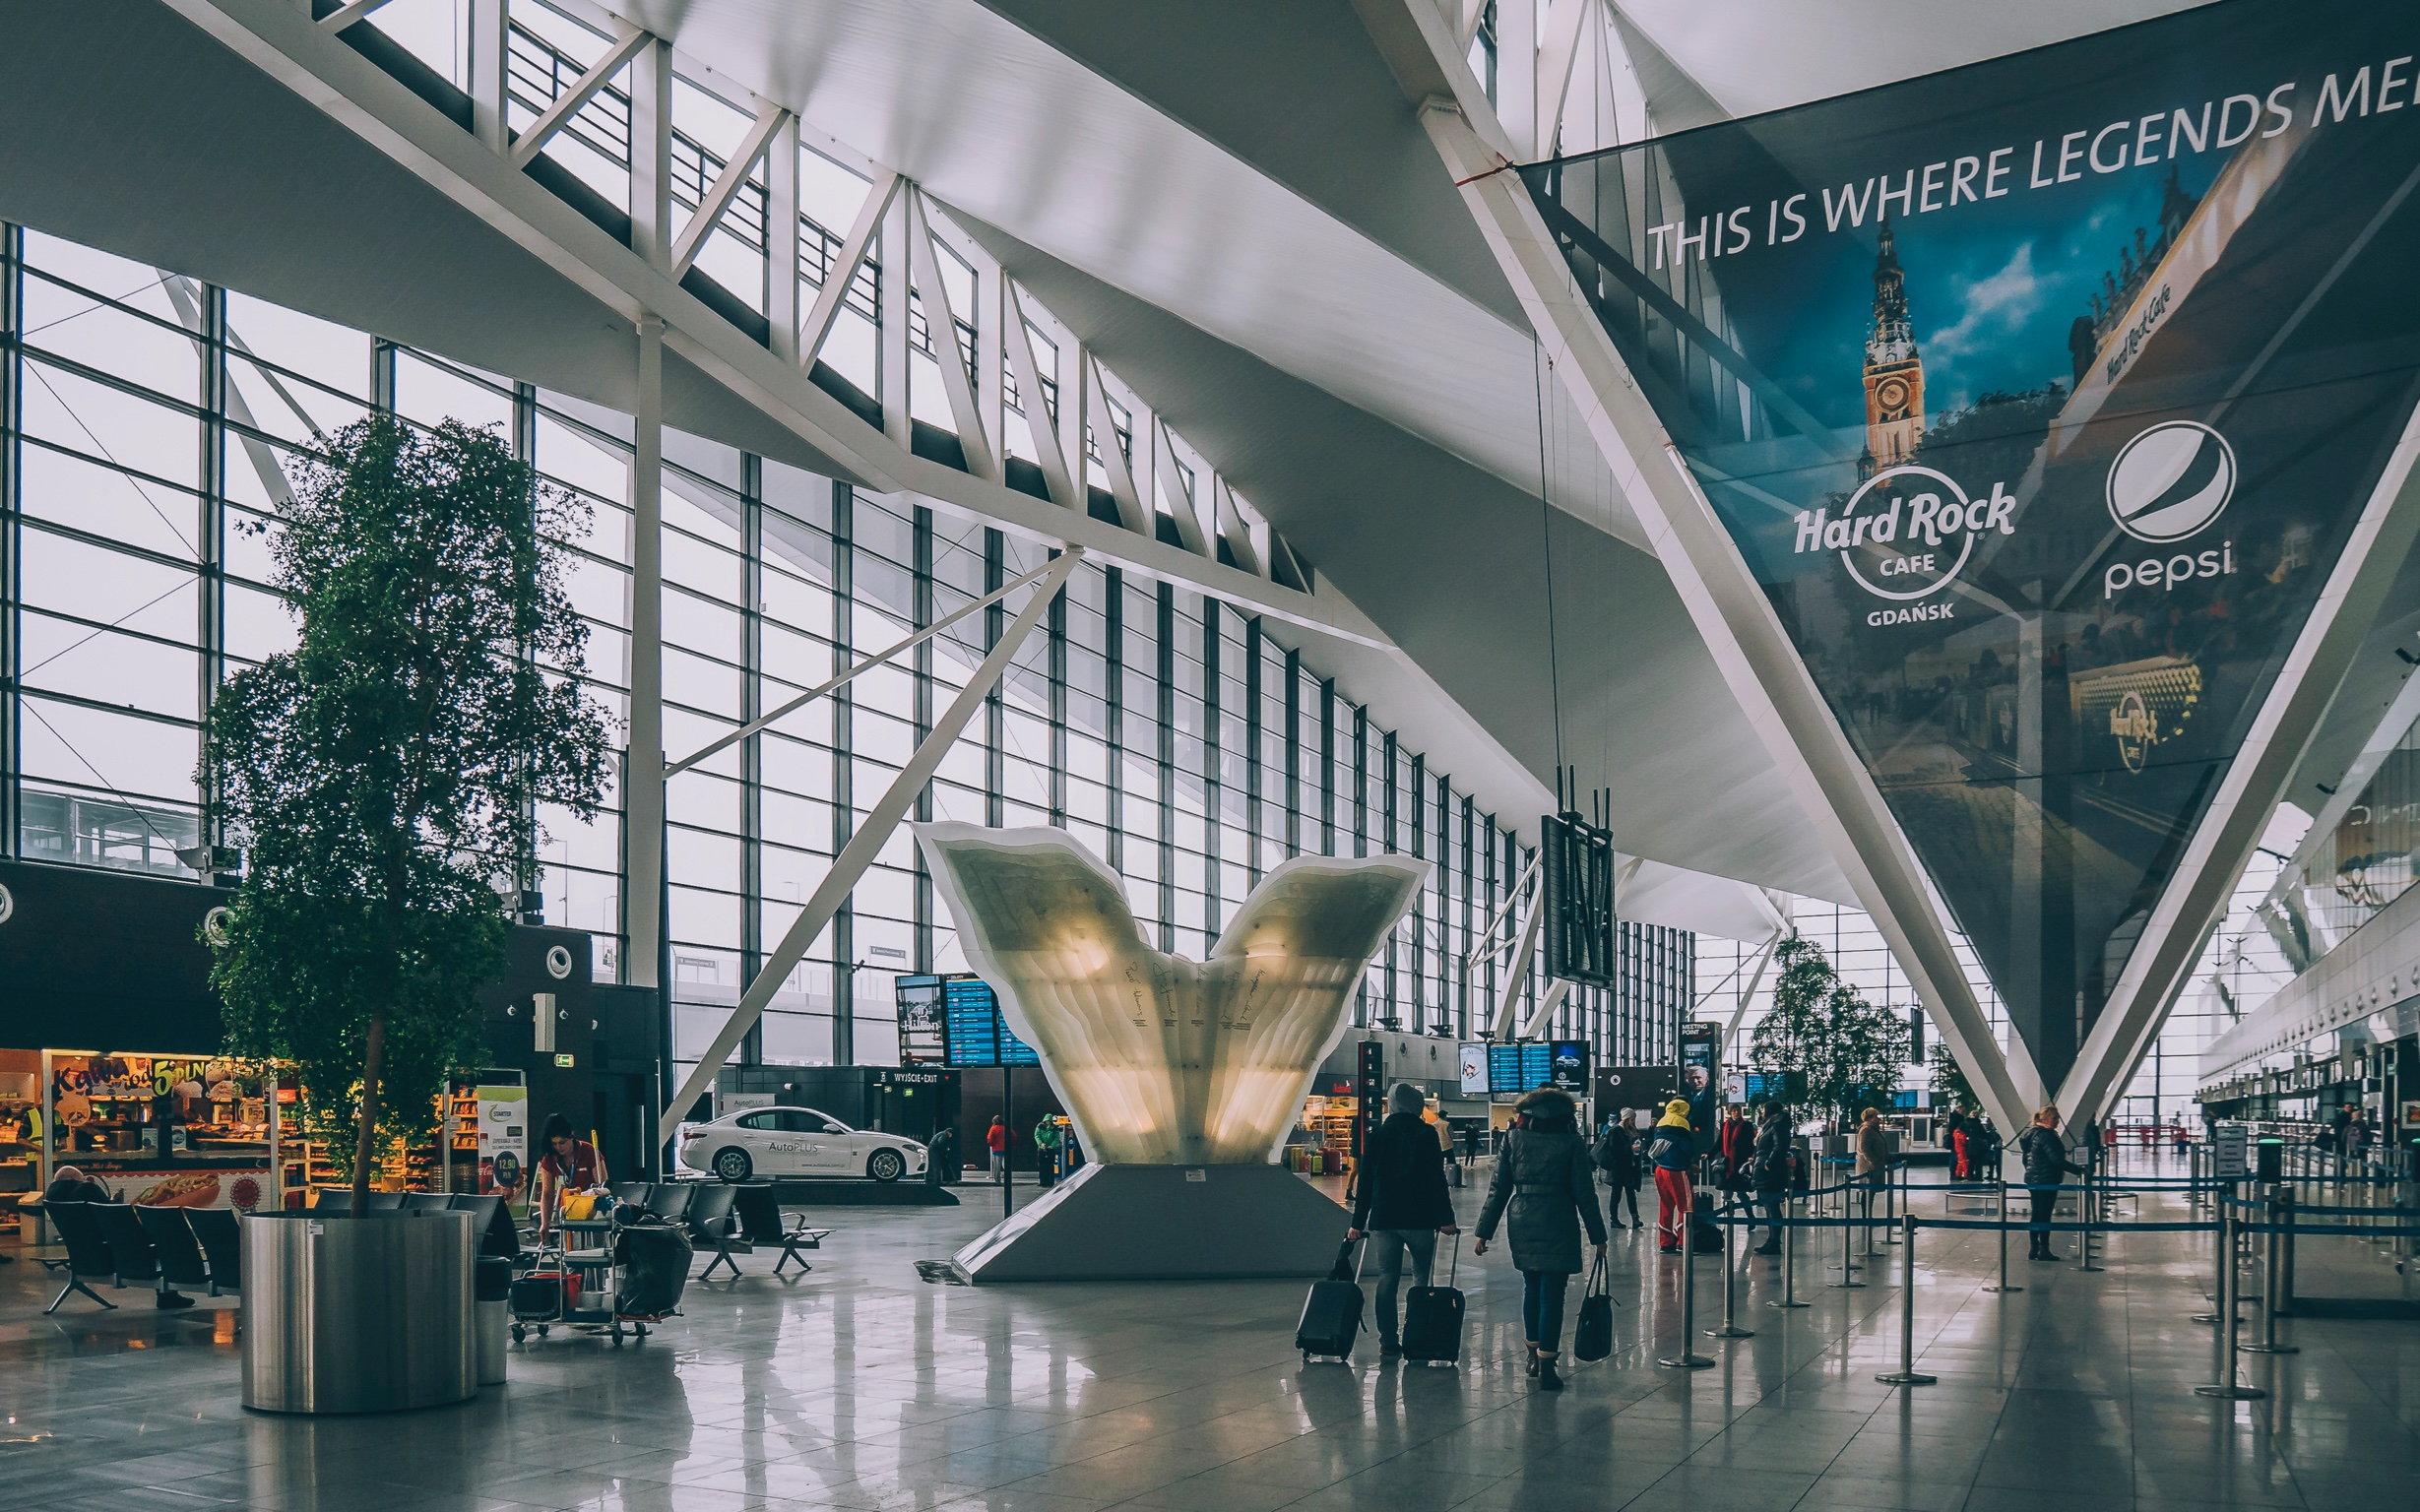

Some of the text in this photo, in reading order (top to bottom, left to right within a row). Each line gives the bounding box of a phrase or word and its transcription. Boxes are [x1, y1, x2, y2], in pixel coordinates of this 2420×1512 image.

[1647, 55, 2420, 270] THIS IS WHERE LEGENDS ME
[1793, 481, 2016, 554] Hard Rock
[1879, 553, 1936, 577] CAFE
[2104, 539, 2232, 599] pepsi
[1867, 601, 1954, 627] GDAŃSK
[903, 1018, 942, 1032] Hilton
[154, 1061, 172, 1096] 5
[175, 1061, 205, 1083] PLN
[768, 1142, 818, 1153] AutoPLUS
[499, 1159, 516, 1169] 12.90
